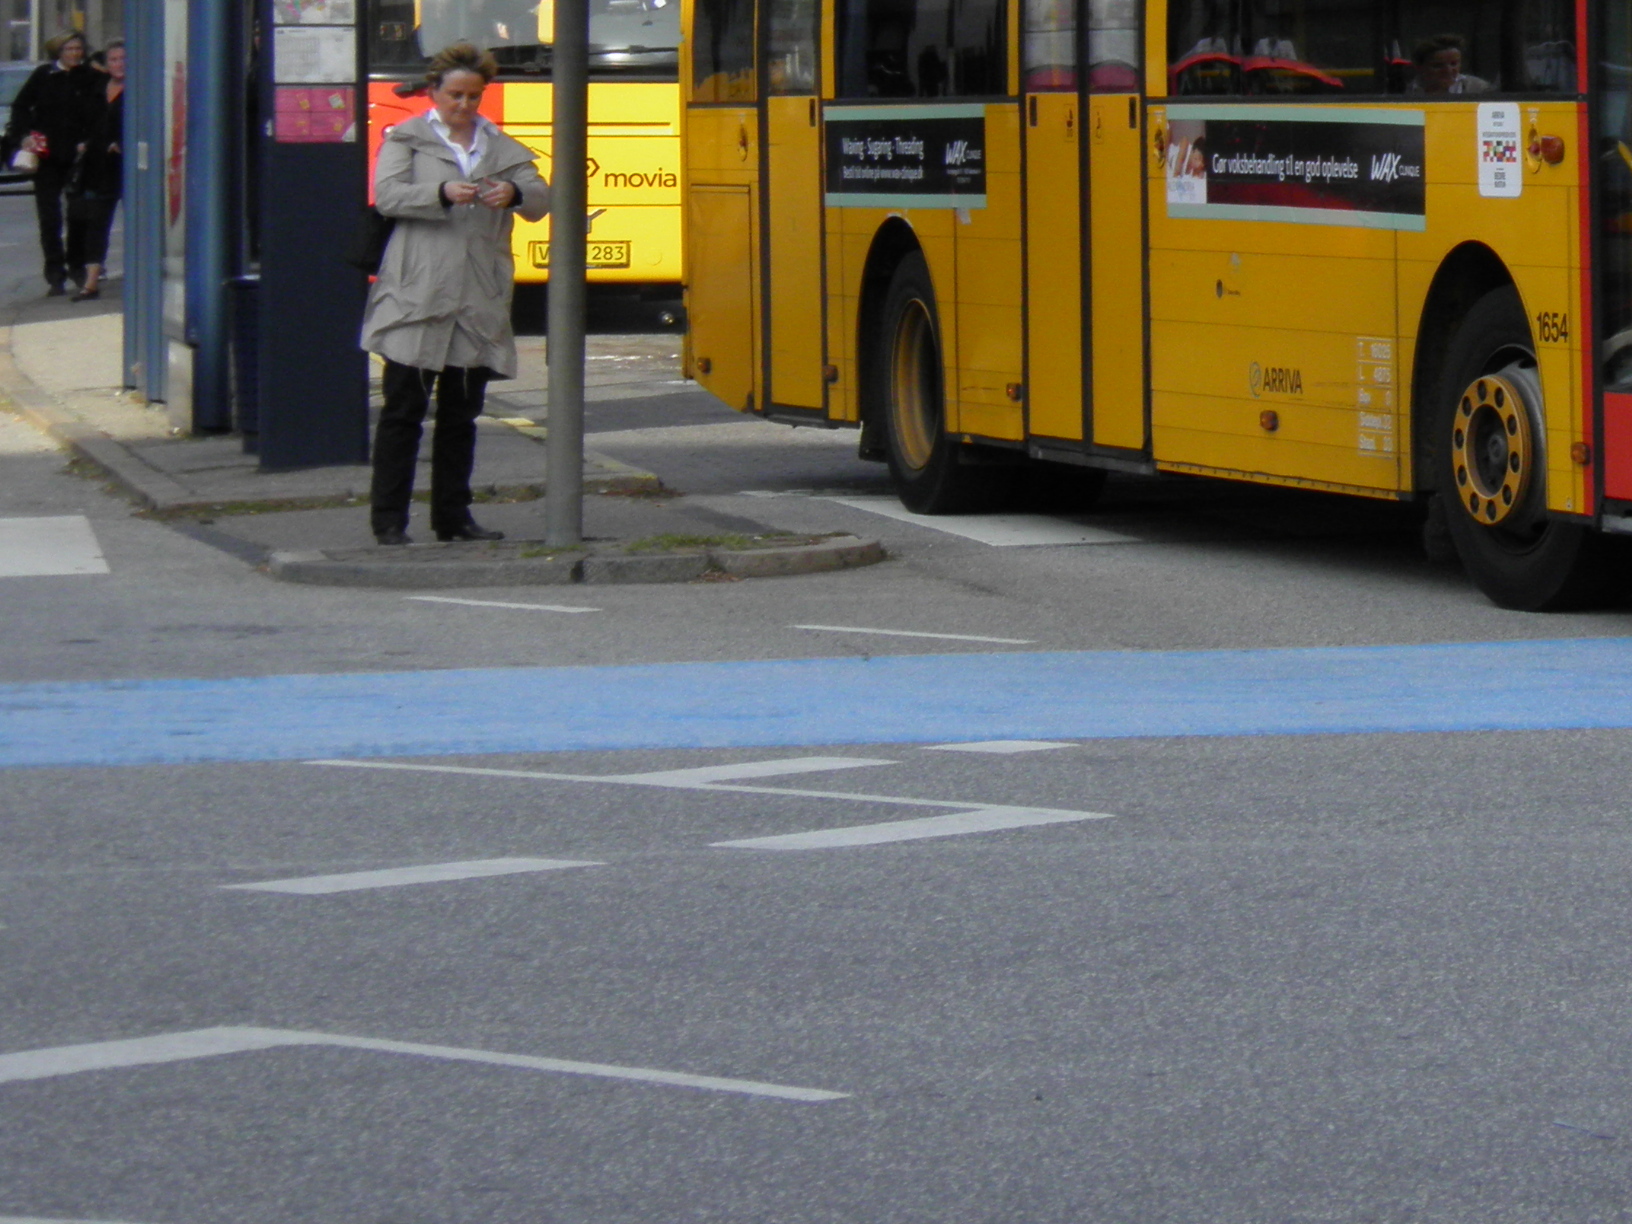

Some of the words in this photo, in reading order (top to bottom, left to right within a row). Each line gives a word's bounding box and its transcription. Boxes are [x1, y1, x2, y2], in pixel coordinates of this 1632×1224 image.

[842, 137, 864, 160] Waxing
[867, 137, 893, 160] Sugaring
[895, 136, 925, 160] Threading
[945, 139, 968, 166] WAX
[604, 167, 678, 188] movia
[1212, 153, 1227, 174] Gør
[1228, 152, 1285, 182] voksbehandling
[1285, 153, 1294, 176] til
[1294, 160, 1304, 176] en
[1305, 154, 1321, 183] god
[1322, 156, 1359, 184] oplevelse
[1370, 152, 1401, 183] WAX
[591, 245, 624, 261] 283
[1536, 310, 1569, 343] 1654
[1263, 367, 1303, 394] ARRIVA
